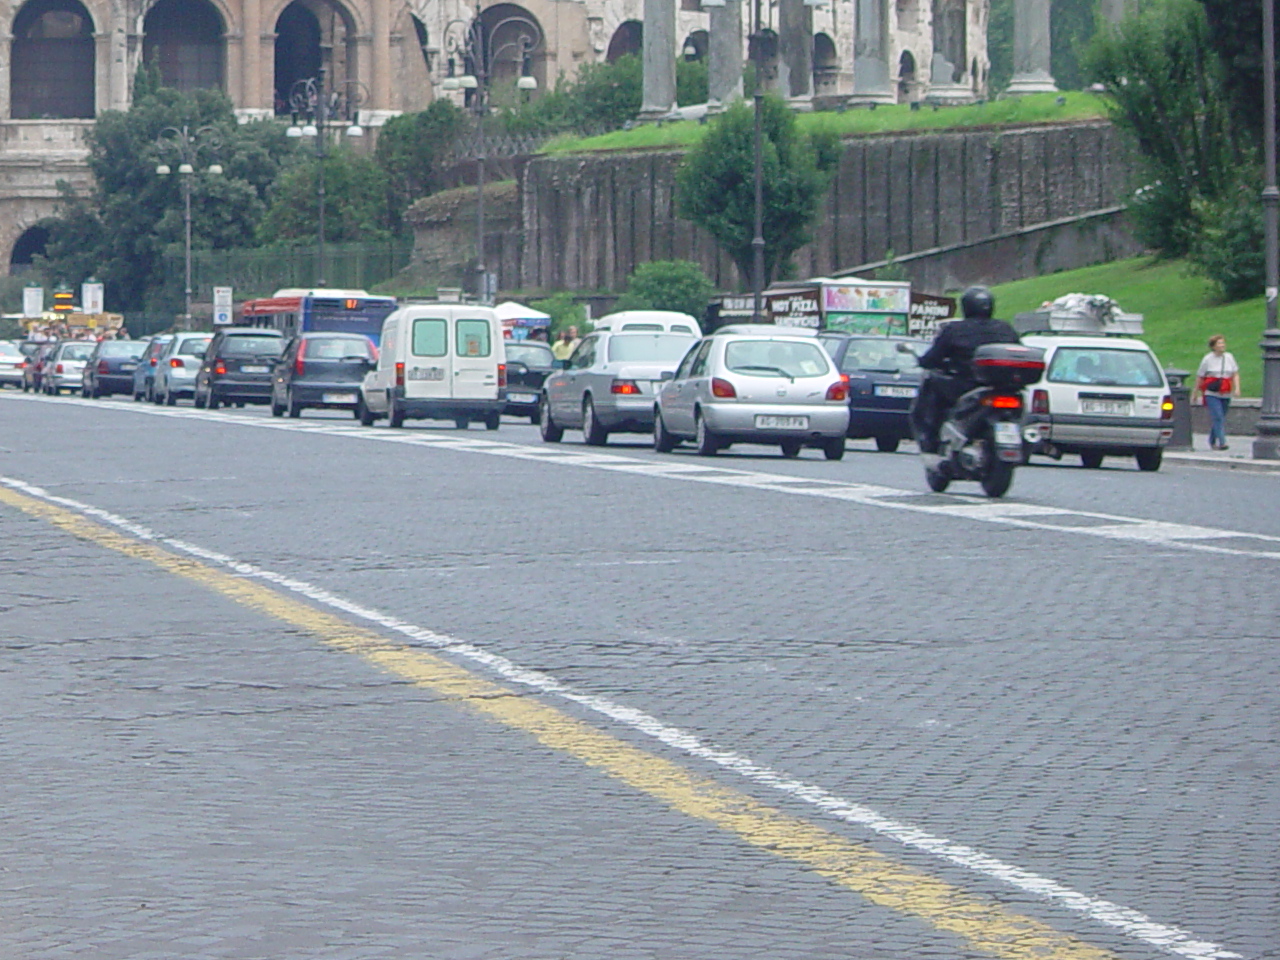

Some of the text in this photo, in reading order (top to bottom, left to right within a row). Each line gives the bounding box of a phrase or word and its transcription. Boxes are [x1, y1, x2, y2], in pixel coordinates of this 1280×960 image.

[771, 300, 789, 312] HOT
[791, 299, 819, 312] PIZZA
[911, 303, 949, 316] PANINI
